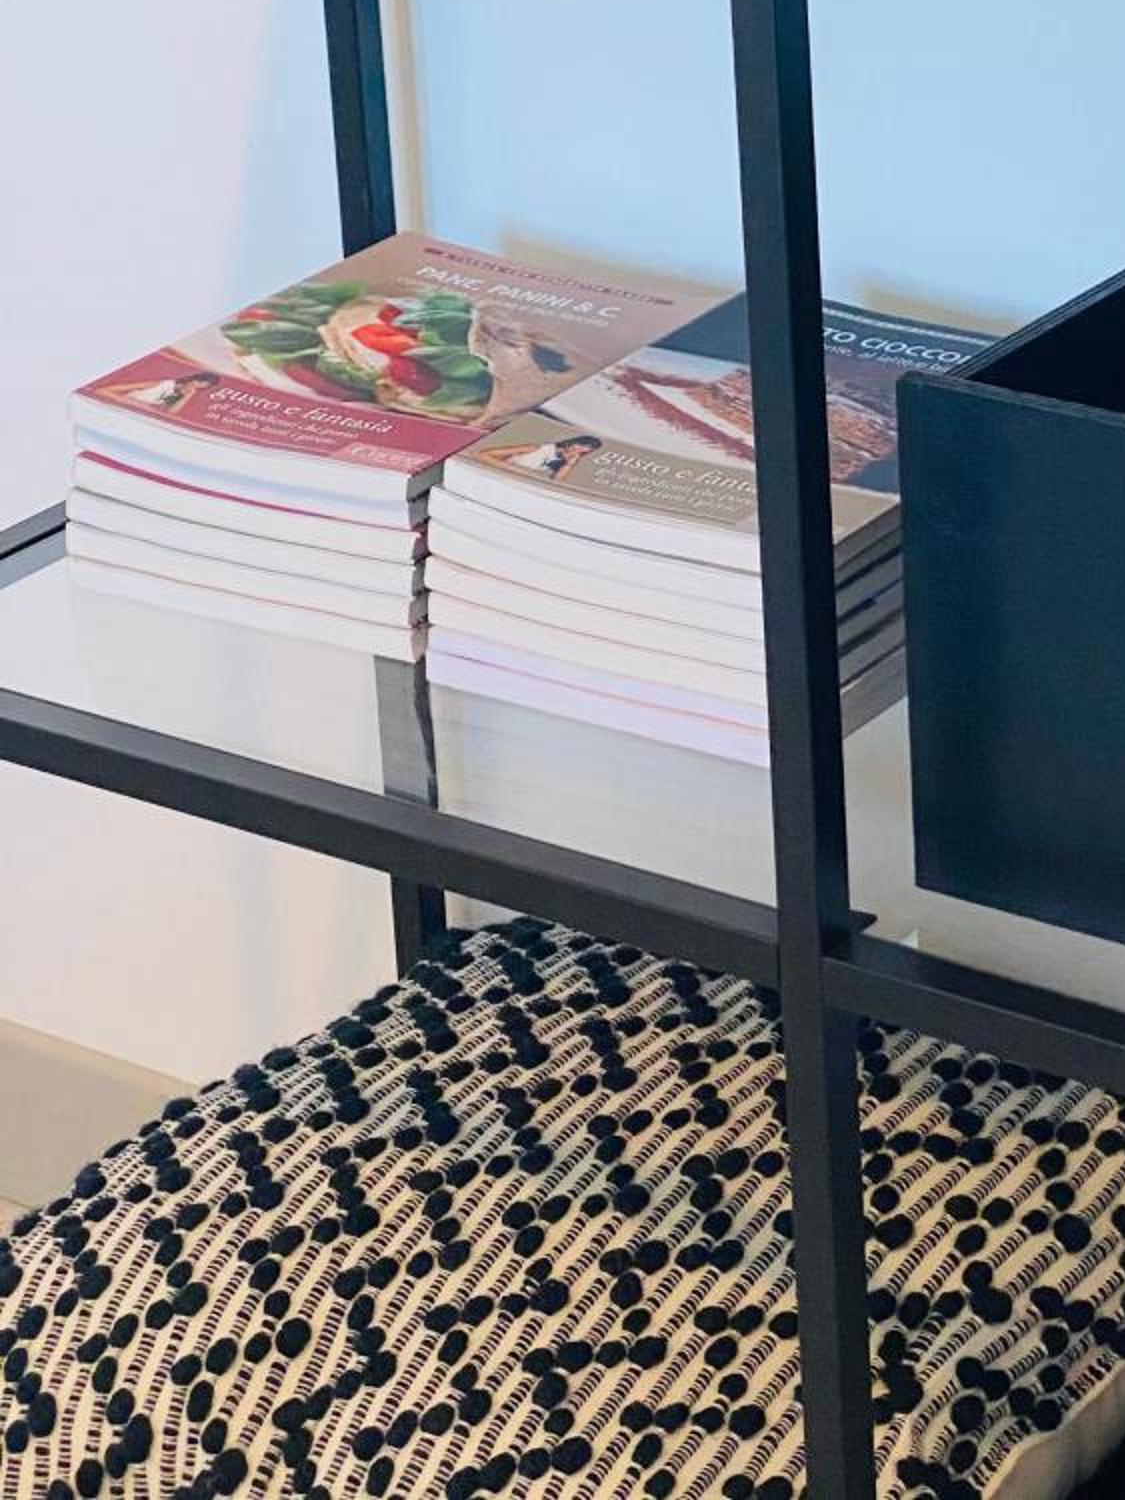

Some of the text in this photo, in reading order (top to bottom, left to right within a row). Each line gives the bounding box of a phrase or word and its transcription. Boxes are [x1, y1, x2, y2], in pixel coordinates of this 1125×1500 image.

[416, 265, 482, 291] PANE
[208, 386, 282, 413] gusto
[303, 405, 394, 435] fantasia
[594, 450, 671, 474] gusto
[674, 469, 693, 480] e
